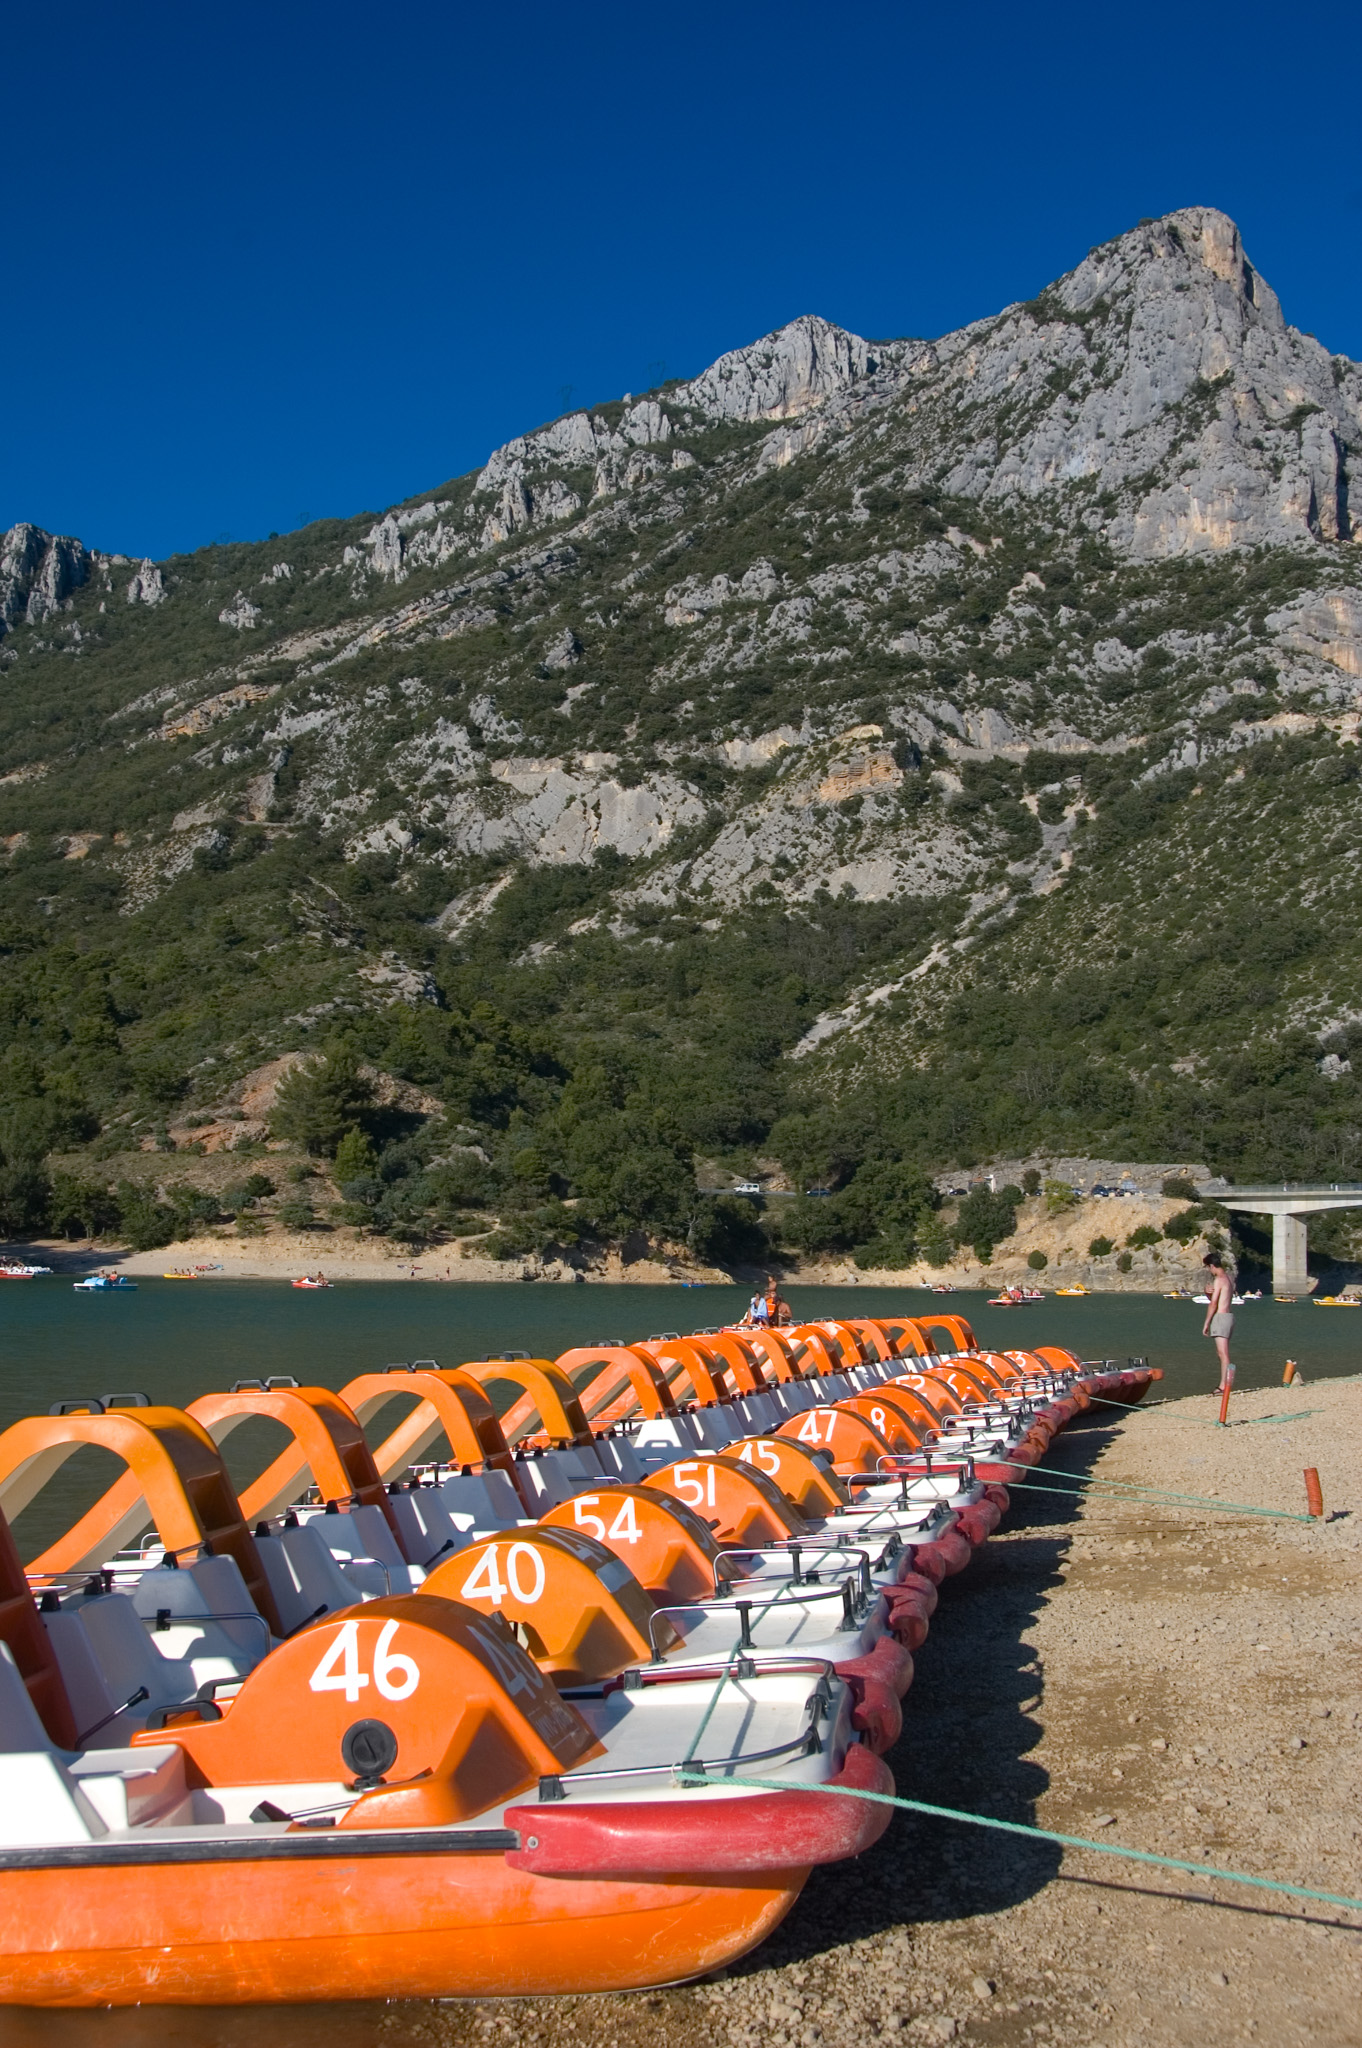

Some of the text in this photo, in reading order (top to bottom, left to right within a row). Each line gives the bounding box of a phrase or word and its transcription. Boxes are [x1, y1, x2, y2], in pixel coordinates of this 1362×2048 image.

[798, 1410, 838, 1443] 47
[673, 1462, 716, 1507] 51
[573, 1496, 643, 1544] 54
[460, 1542, 546, 1605] 40
[309, 1618, 420, 1702] 46
[465, 1619, 544, 1700] 46
